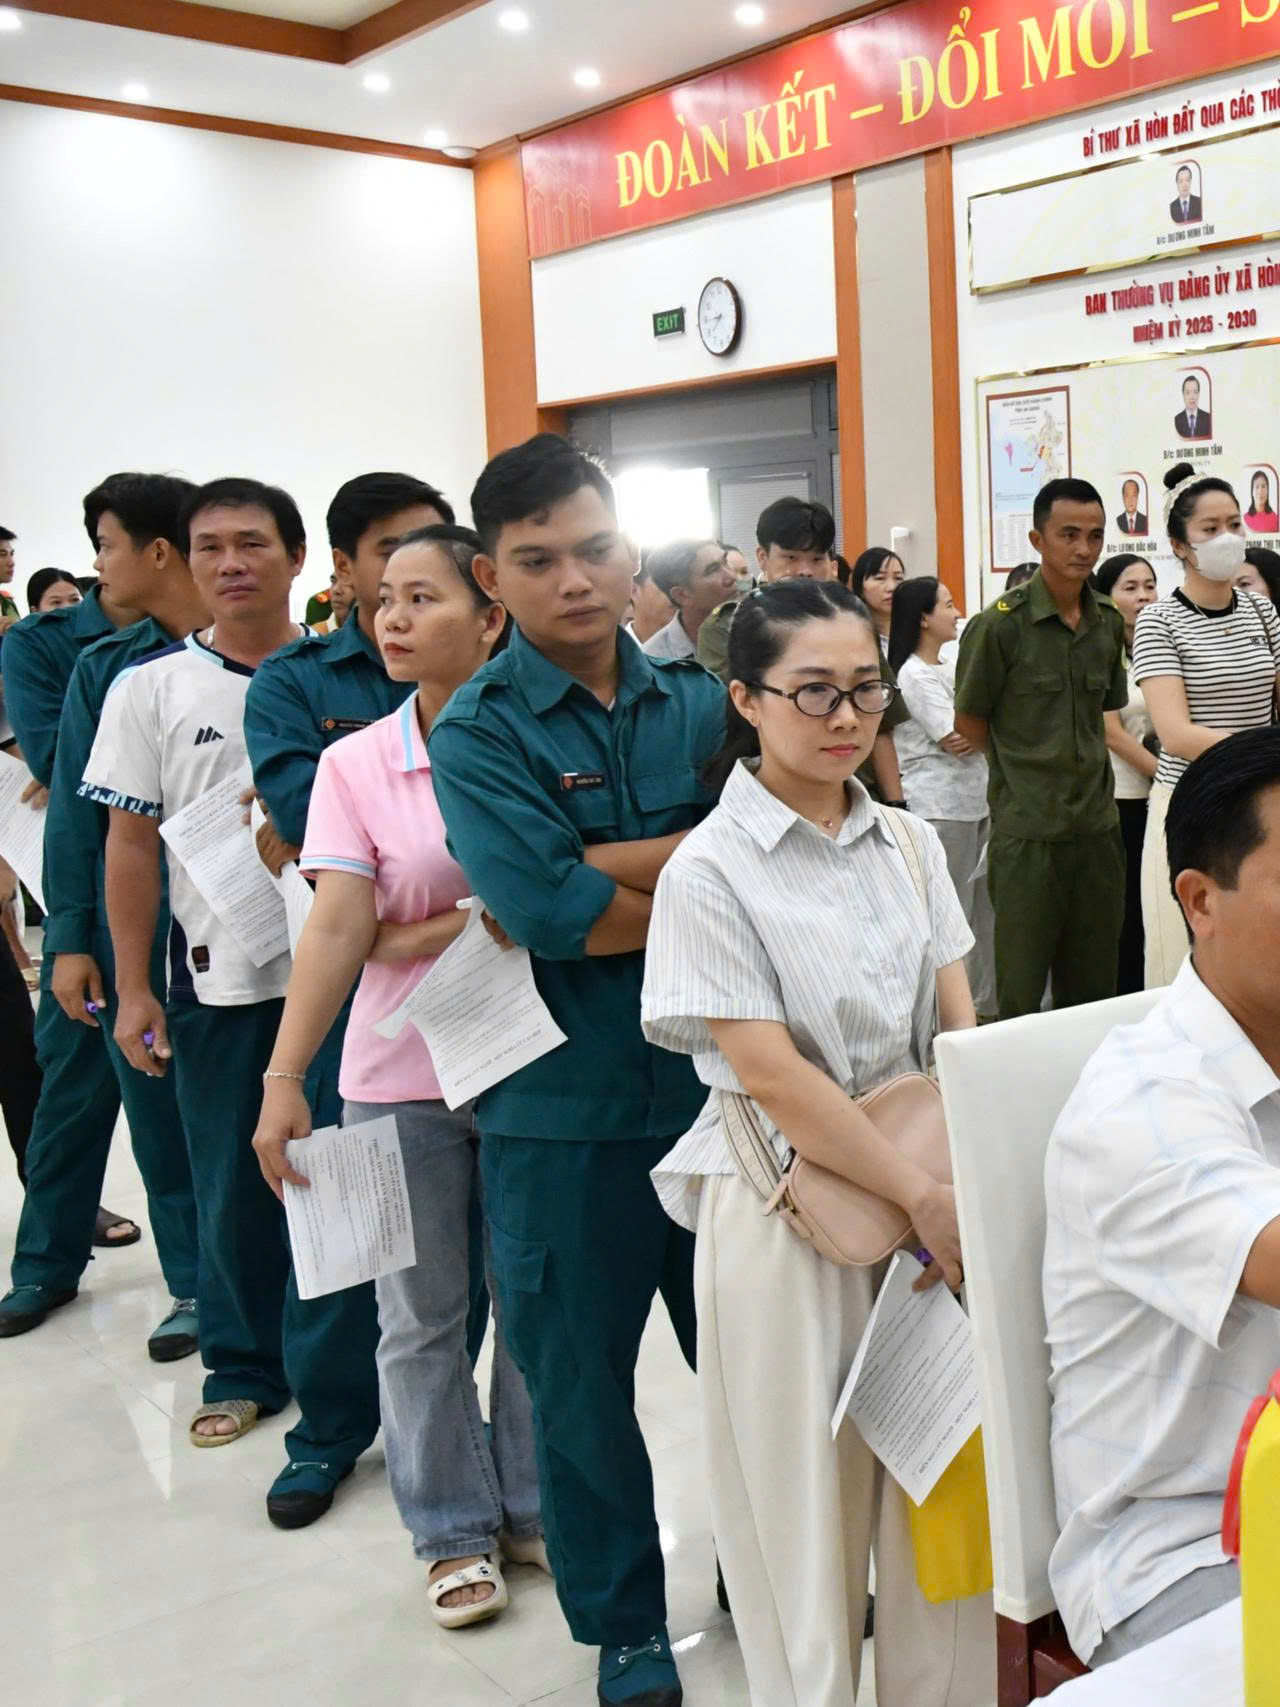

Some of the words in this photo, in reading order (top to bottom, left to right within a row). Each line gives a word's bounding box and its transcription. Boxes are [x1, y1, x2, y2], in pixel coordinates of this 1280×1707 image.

[614, 114, 729, 208] ĐOÀN
[744, 69, 837, 171] KẾT
[896, 6, 1003, 125] ĐỔI
[1083, 128, 1094, 157] BÍ
[1098, 126, 1121, 153] THƯ
[1125, 119, 1141, 147] XÃ
[1145, 112, 1168, 142] HÒN
[1173, 100, 1195, 135] ĐẤT
[1200, 102, 1225, 128] QUA
[1230, 89, 1254, 121] CÁC
[1085, 293, 1107, 316] BAN
[1111, 279, 1154, 312] THƯỜNG
[1159, 281, 1173, 309] VỤ
[1178, 270, 1210, 301] ĐẢNG
[1214, 265, 1231, 295] ỦY
[1235, 262, 1252, 292] XÃ
[656, 313, 679, 332] EXIT
[1133, 318, 1164, 345] NHIỆM
[1168, 314, 1181, 338] KỲ
[1186, 315, 1213, 336] 2025
[1227, 308, 1257, 329] 2030
